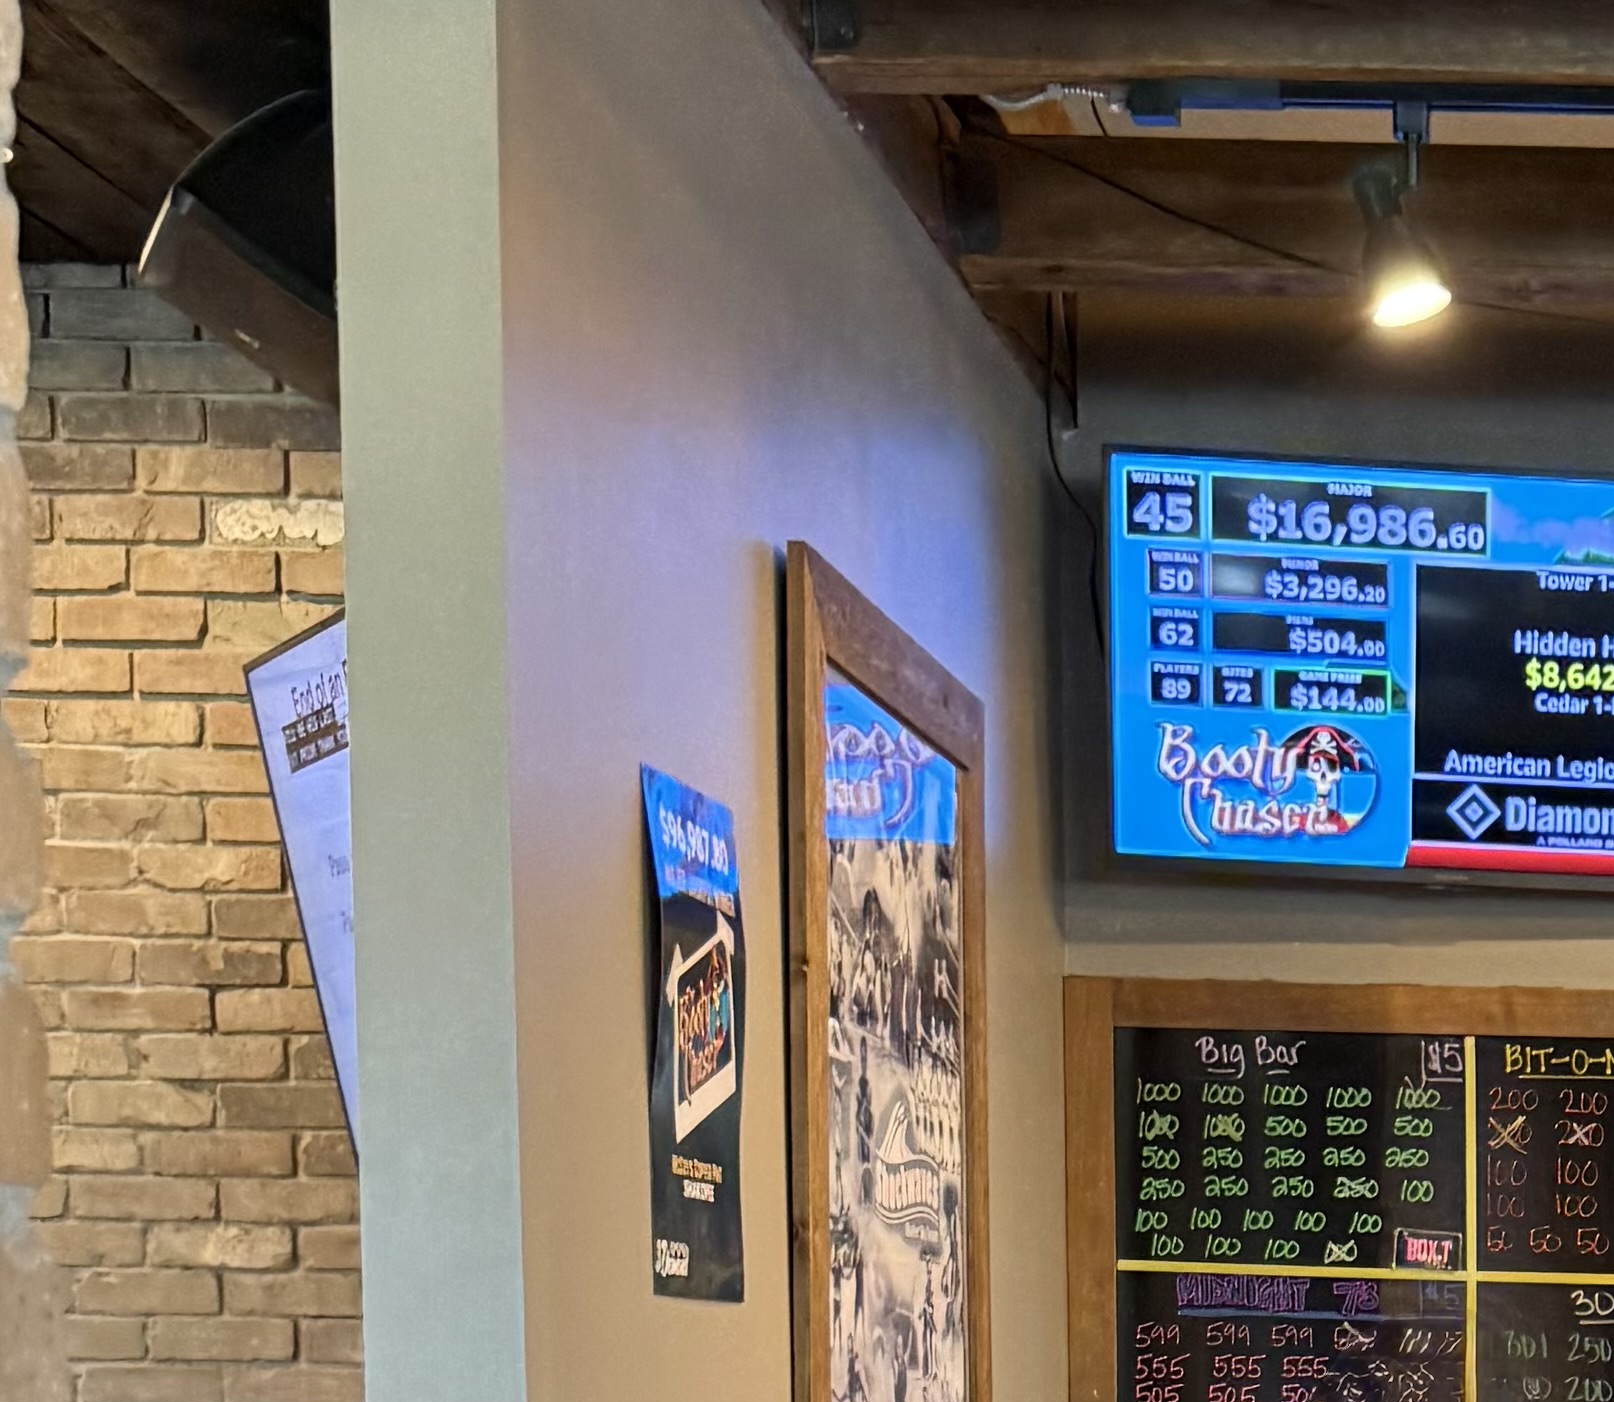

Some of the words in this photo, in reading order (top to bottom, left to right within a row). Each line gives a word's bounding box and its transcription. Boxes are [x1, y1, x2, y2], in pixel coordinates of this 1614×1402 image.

[1131, 471, 1159, 485] WIN
[1133, 492, 1193, 532] 45
[1248, 493, 1484, 550] $16,986.60
[1158, 567, 1194, 591] 50
[1265, 569, 1385, 603] $3,296.20
[1536, 571, 1593, 591] Tower
[1158, 622, 1194, 646] 62
[1289, 627, 1385, 657] $504.00
[1514, 629, 1596, 657] Hidden
[1161, 678, 1191, 699] 89
[1223, 681, 1252, 703] 72
[1290, 684, 1385, 713] $144.00
[1534, 693, 1589, 714] Cedar
[1155, 721, 1300, 794] Booty
[1444, 750, 1550, 777] American
[1255, 1035, 1306, 1066] Bar
[1427, 1042, 1463, 1073] $5
[1137, 1078, 1180, 1103] 1000
[1202, 1083, 1244, 1106] 1000
[1264, 1084, 1308, 1106] 1000
[1327, 1086, 1372, 1107] 1000
[1488, 1087, 1539, 1111] 200
[1559, 1089, 1607, 1114] 200
[1407, 1237, 1438, 1265] BOX
[1136, 1321, 1180, 1348] 599
[1206, 1322, 1250, 1347] 599
[1272, 1325, 1313, 1348] 599
